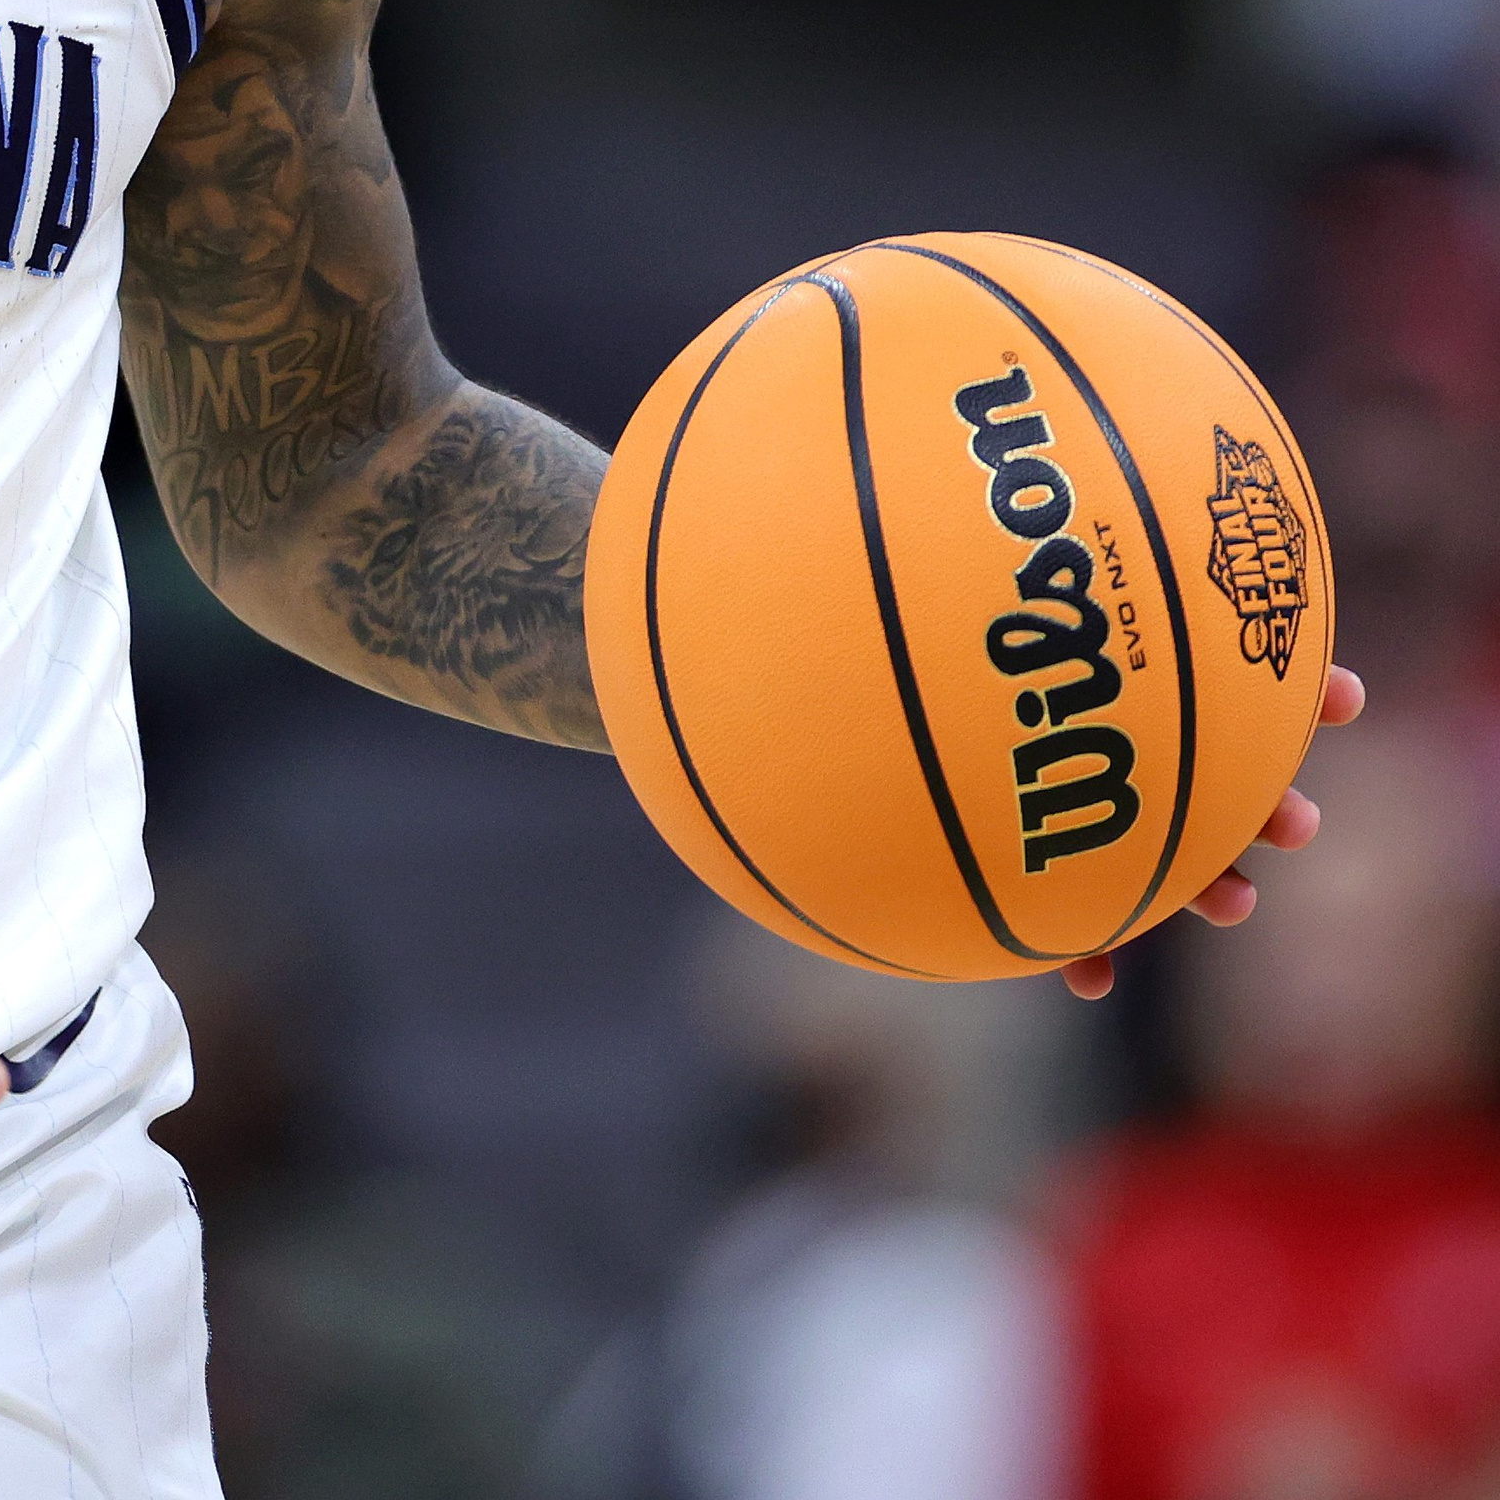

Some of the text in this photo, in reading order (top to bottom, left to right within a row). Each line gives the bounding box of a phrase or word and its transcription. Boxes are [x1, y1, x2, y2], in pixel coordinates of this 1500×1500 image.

[1093, 519, 1146, 672] EVO NXT
[1210, 486, 1271, 614] FINAL
[1242, 485, 1300, 608] FOUR
[954, 363, 1142, 875] Wilson
